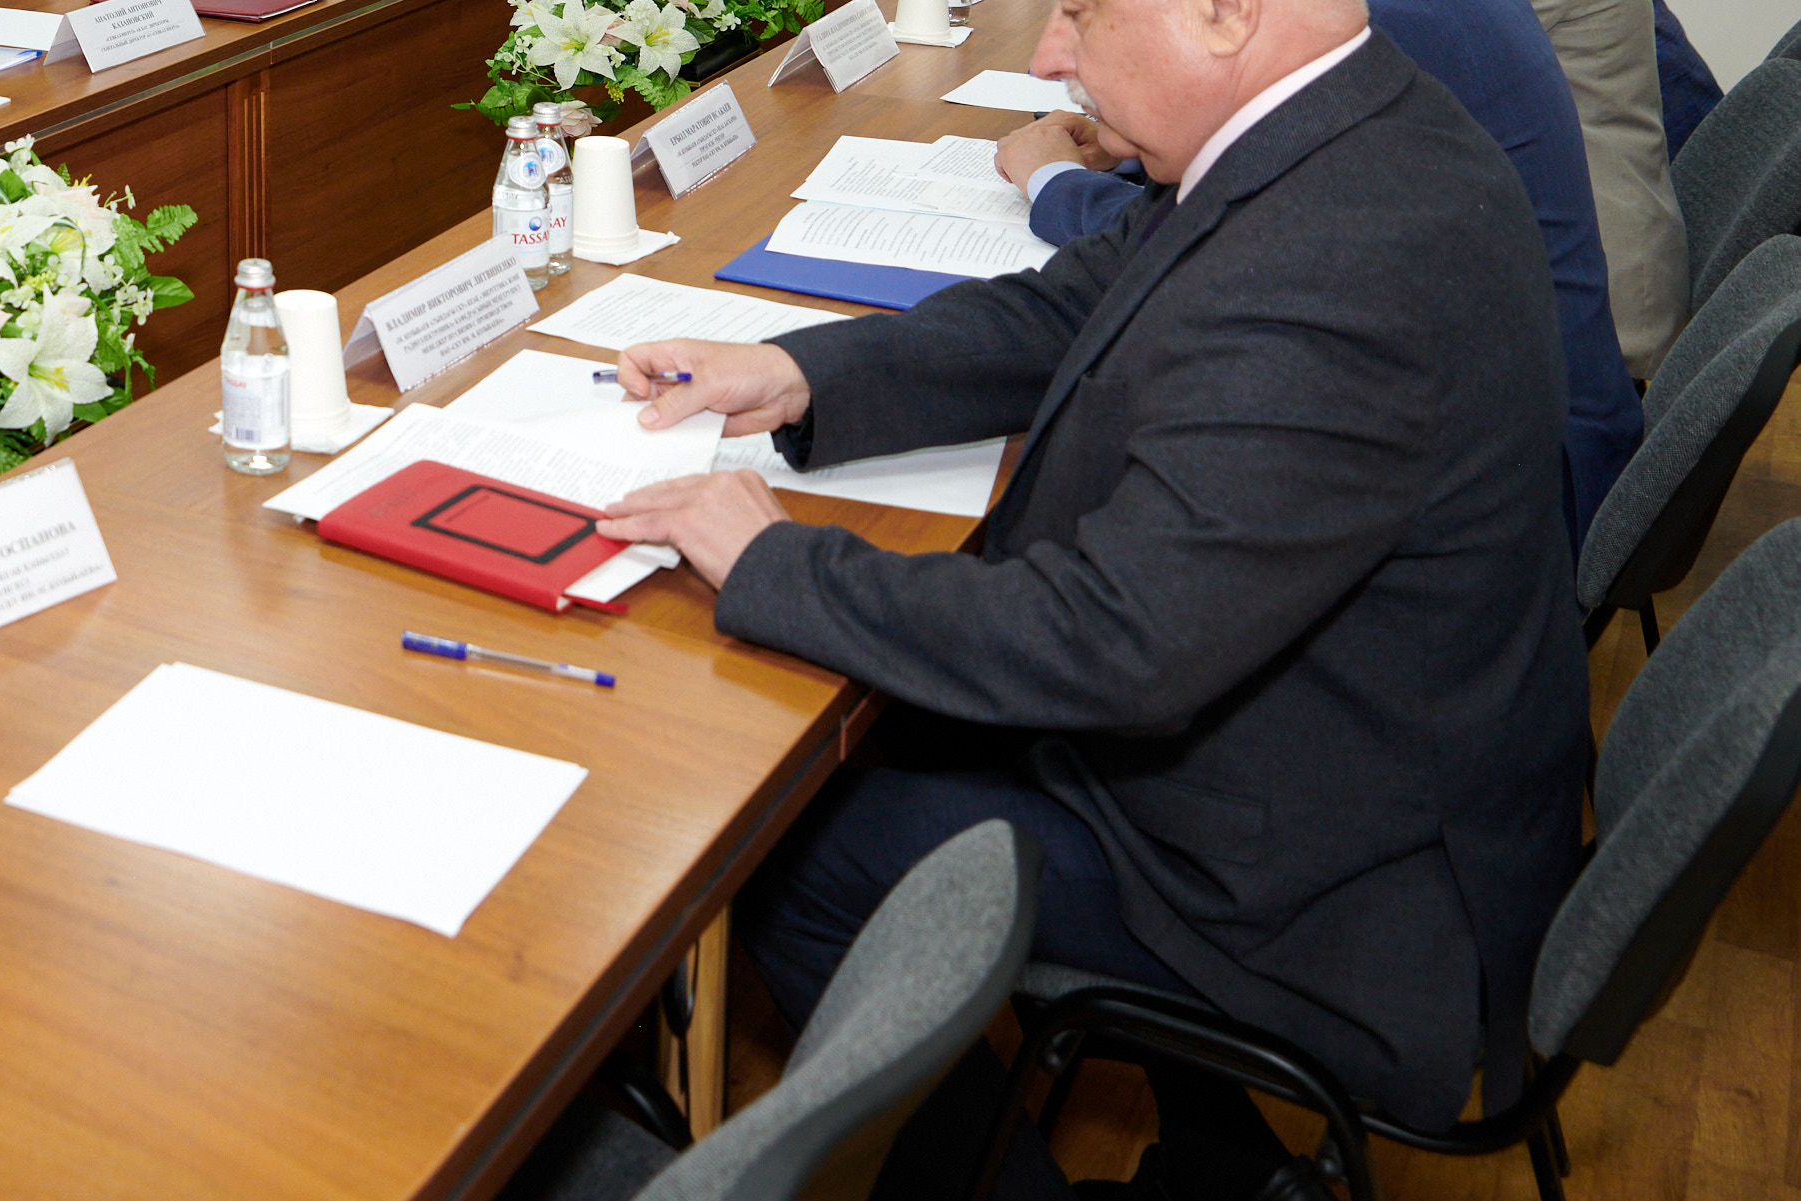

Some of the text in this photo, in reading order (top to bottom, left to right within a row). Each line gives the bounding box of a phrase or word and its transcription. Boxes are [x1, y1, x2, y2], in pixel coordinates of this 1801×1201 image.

[94, 7, 128, 24] АНАТОЛИЙ
[111, 10, 155, 30] КАЗАНОВСКИЙ
[385, 256, 517, 332] ВЛАДИМИР ВИКТОРОВИЧ ЛИТВИНЕНКО
